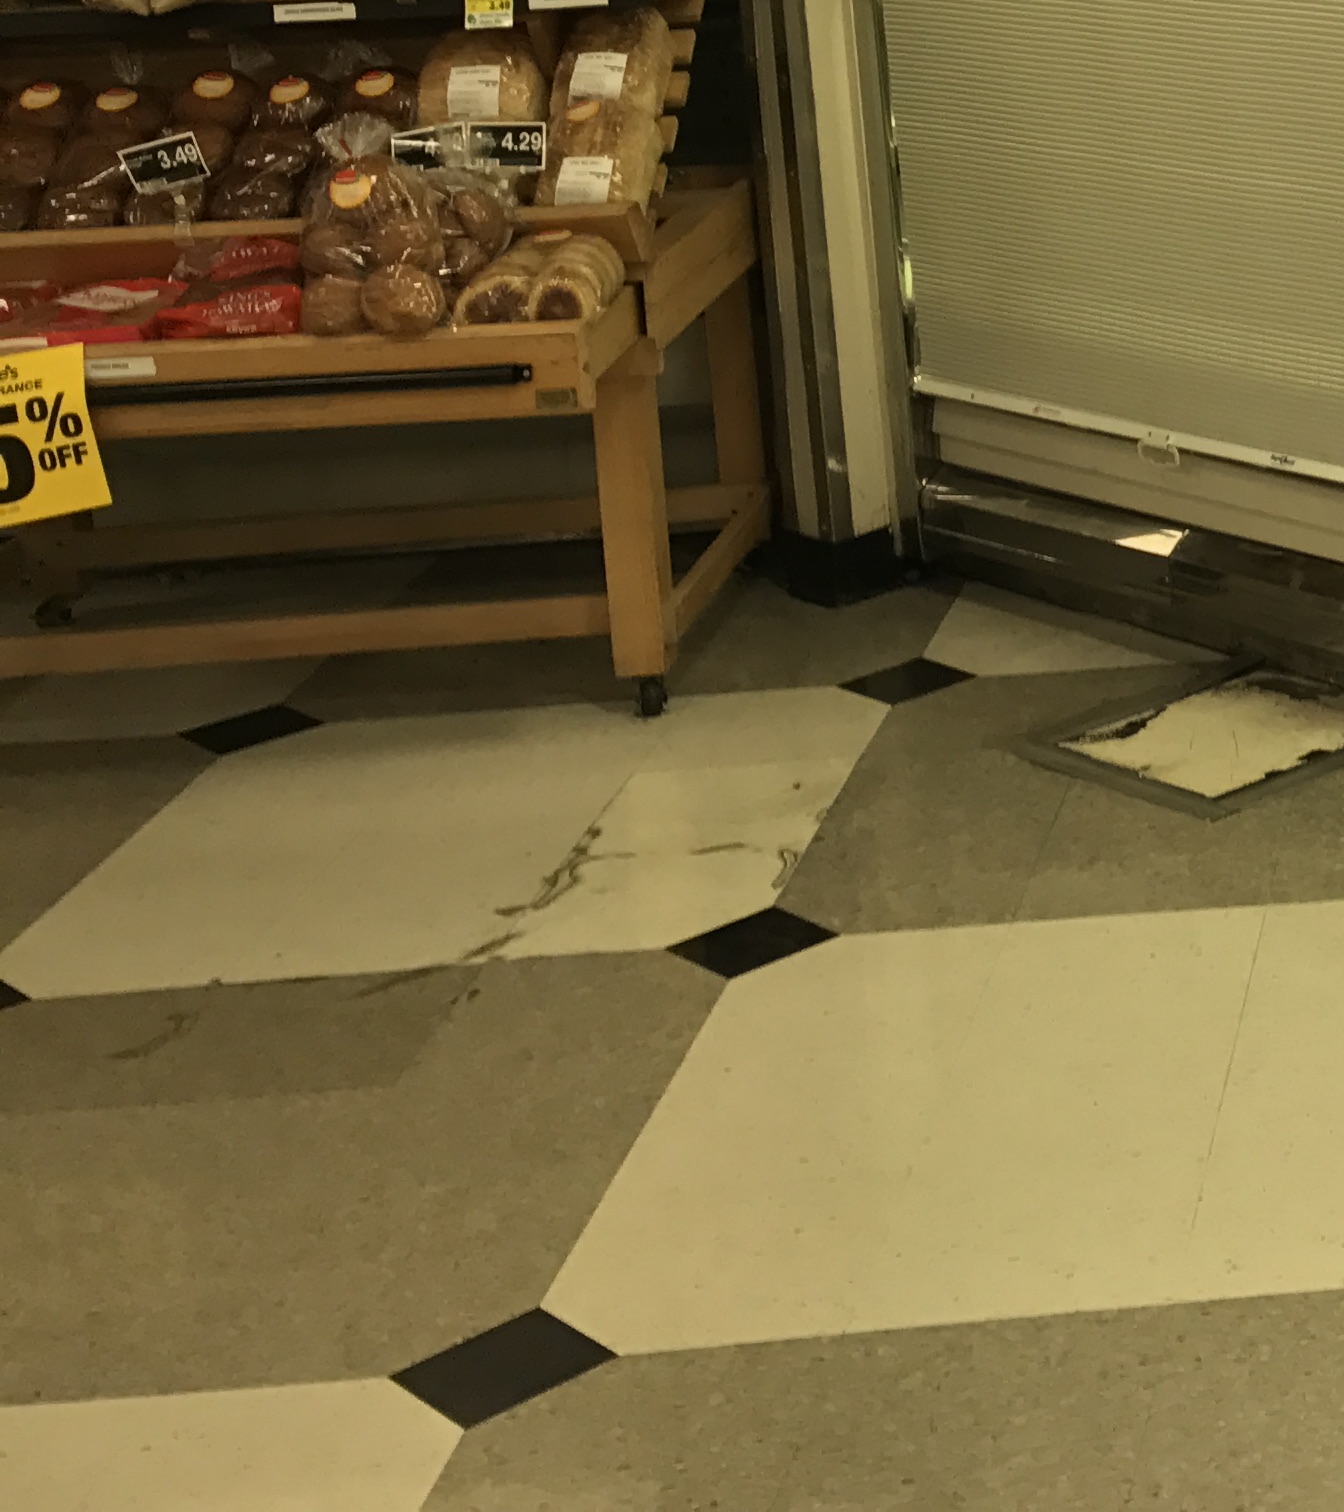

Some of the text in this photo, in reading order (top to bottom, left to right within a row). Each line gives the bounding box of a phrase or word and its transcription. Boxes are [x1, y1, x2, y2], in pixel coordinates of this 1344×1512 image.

[501, 130, 543, 152] 4.29
[156, 143, 199, 172] 3.49
[38, 441, 89, 472] OFF
